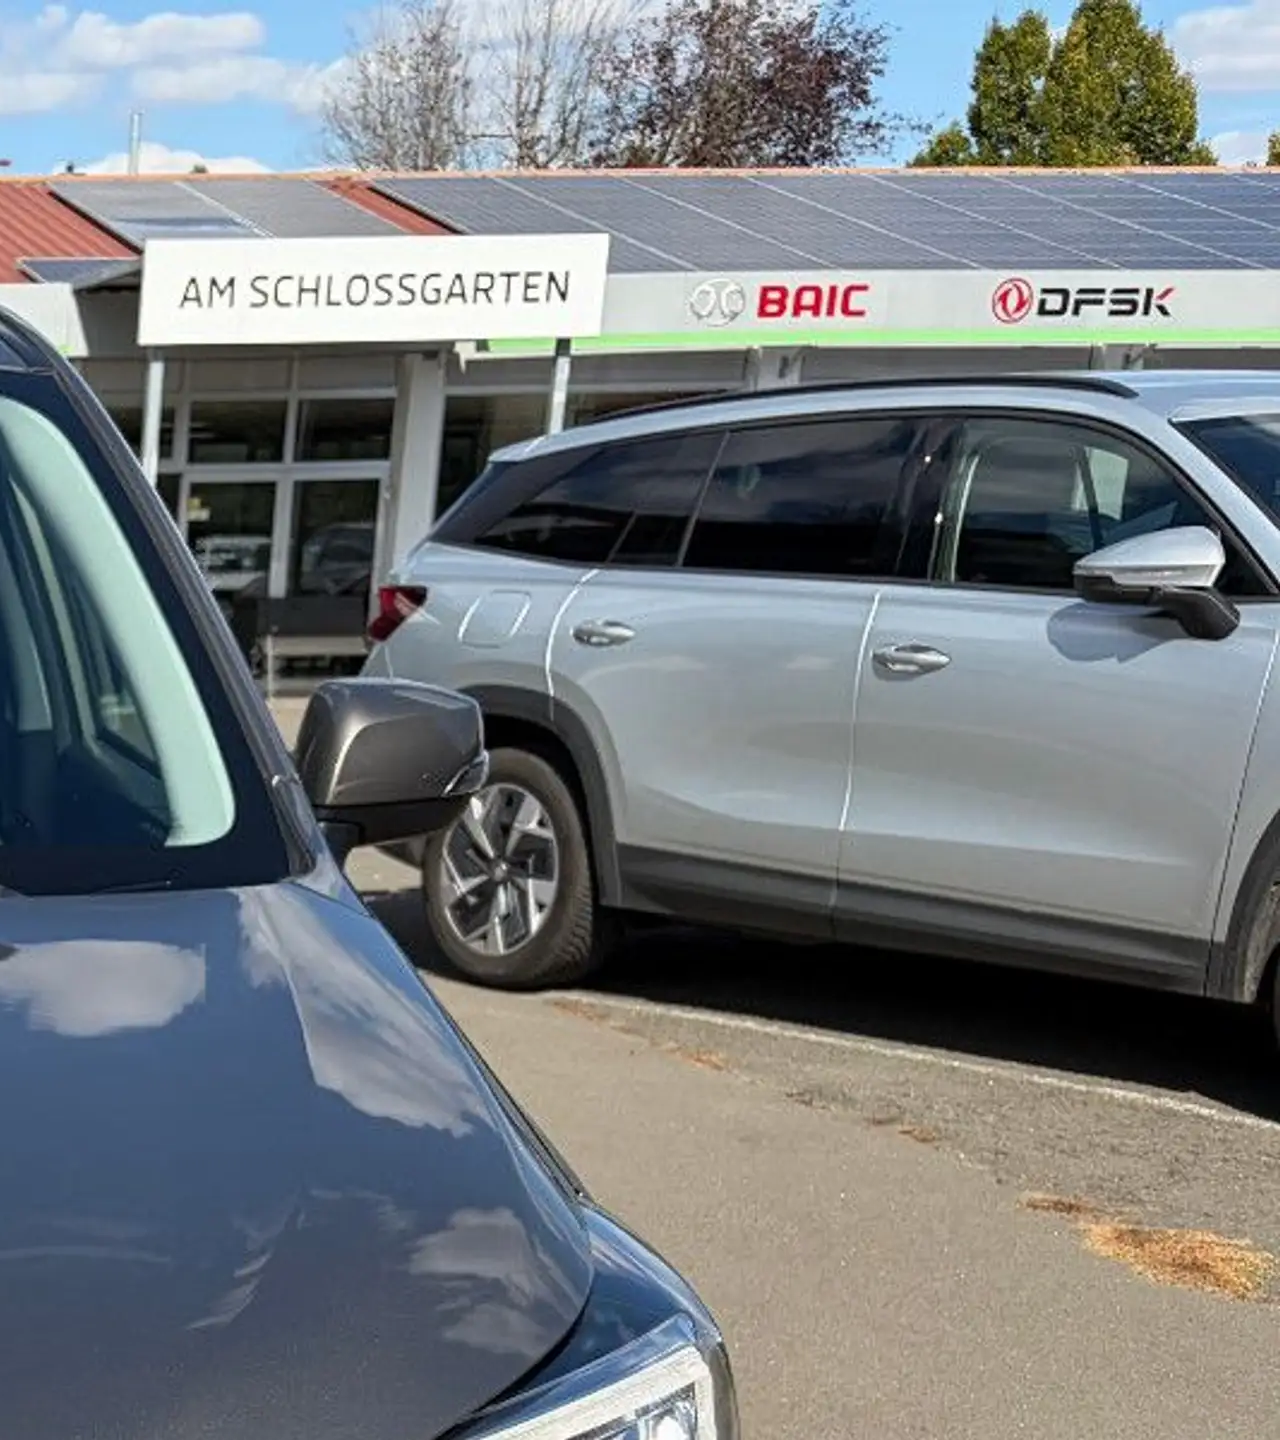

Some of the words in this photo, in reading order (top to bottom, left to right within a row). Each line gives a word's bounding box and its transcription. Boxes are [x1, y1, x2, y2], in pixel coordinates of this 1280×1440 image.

[179, 276, 236, 309] AM
[249, 270, 572, 308] SCHLOSSGARTEN
[756, 285, 869, 318] BAIC
[1036, 287, 1177, 317] DFSK
